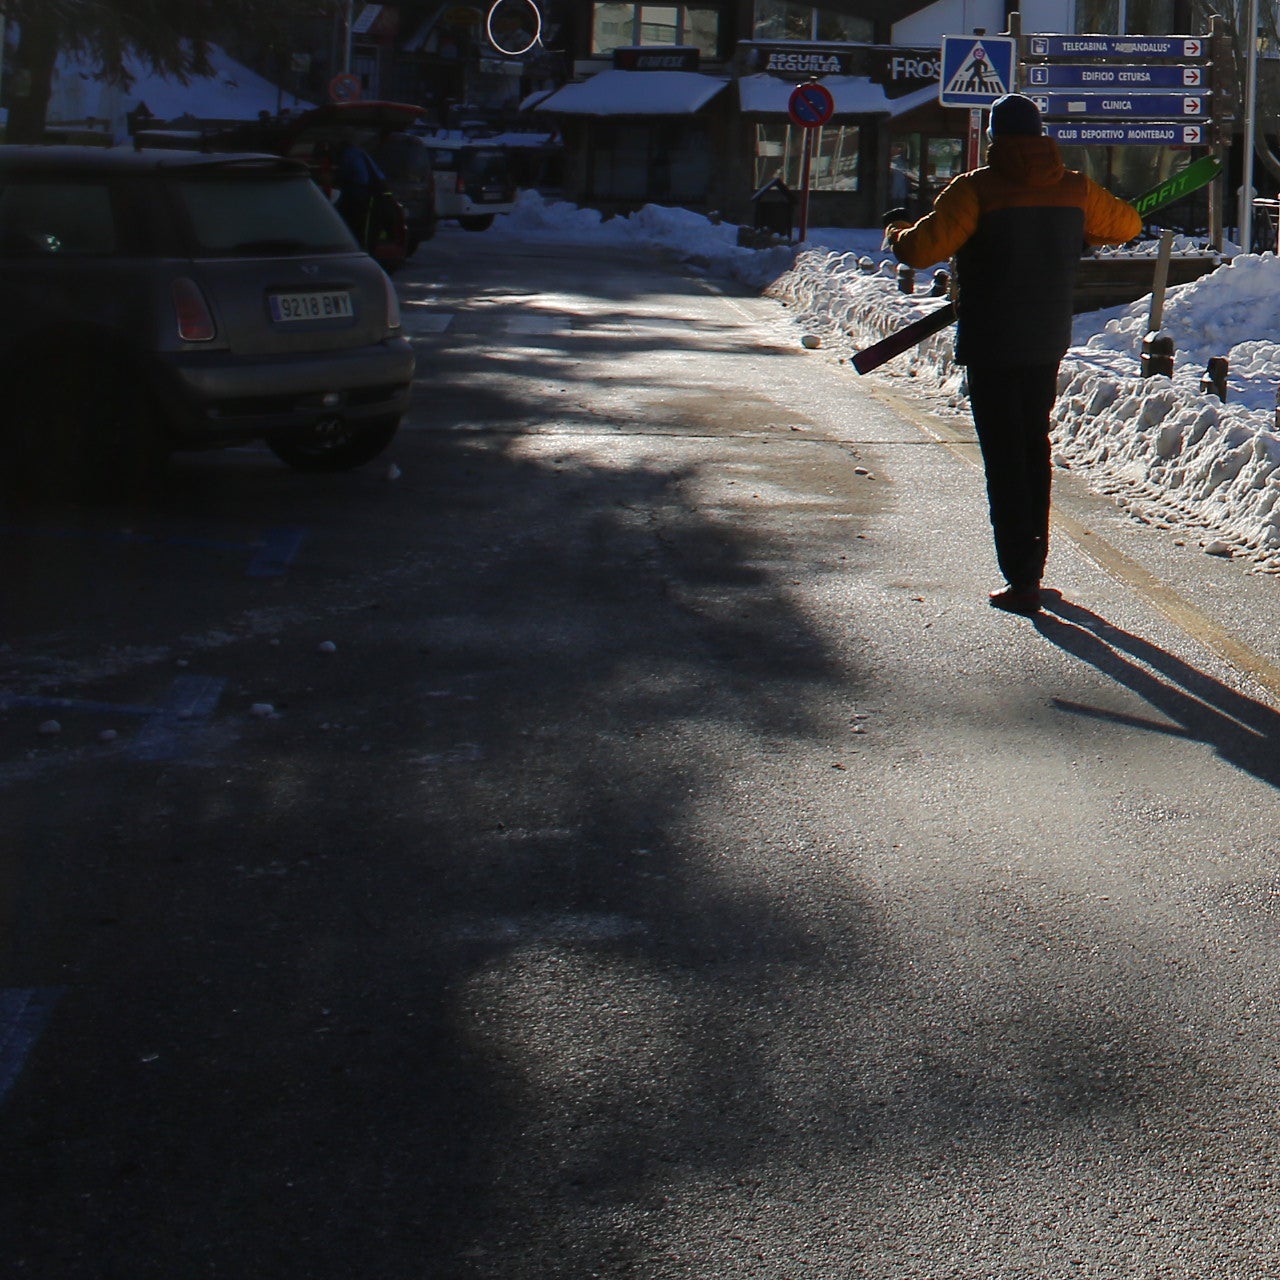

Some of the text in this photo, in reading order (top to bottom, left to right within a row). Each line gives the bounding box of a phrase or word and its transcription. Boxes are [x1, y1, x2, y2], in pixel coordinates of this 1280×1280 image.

[1062, 42, 1108, 51] TELECABINA
[769, 53, 839, 64] ESCUELA
[766, 62, 842, 72] ALQUILER
[1082, 71, 1151, 81] EDIFICIO CETURSA
[1101, 100, 1132, 110] CLINICA
[1057, 129, 1175, 139] CLUB DEPORTIVO MONTEBAJO
[281, 294, 349, 318] 9218 BWY
